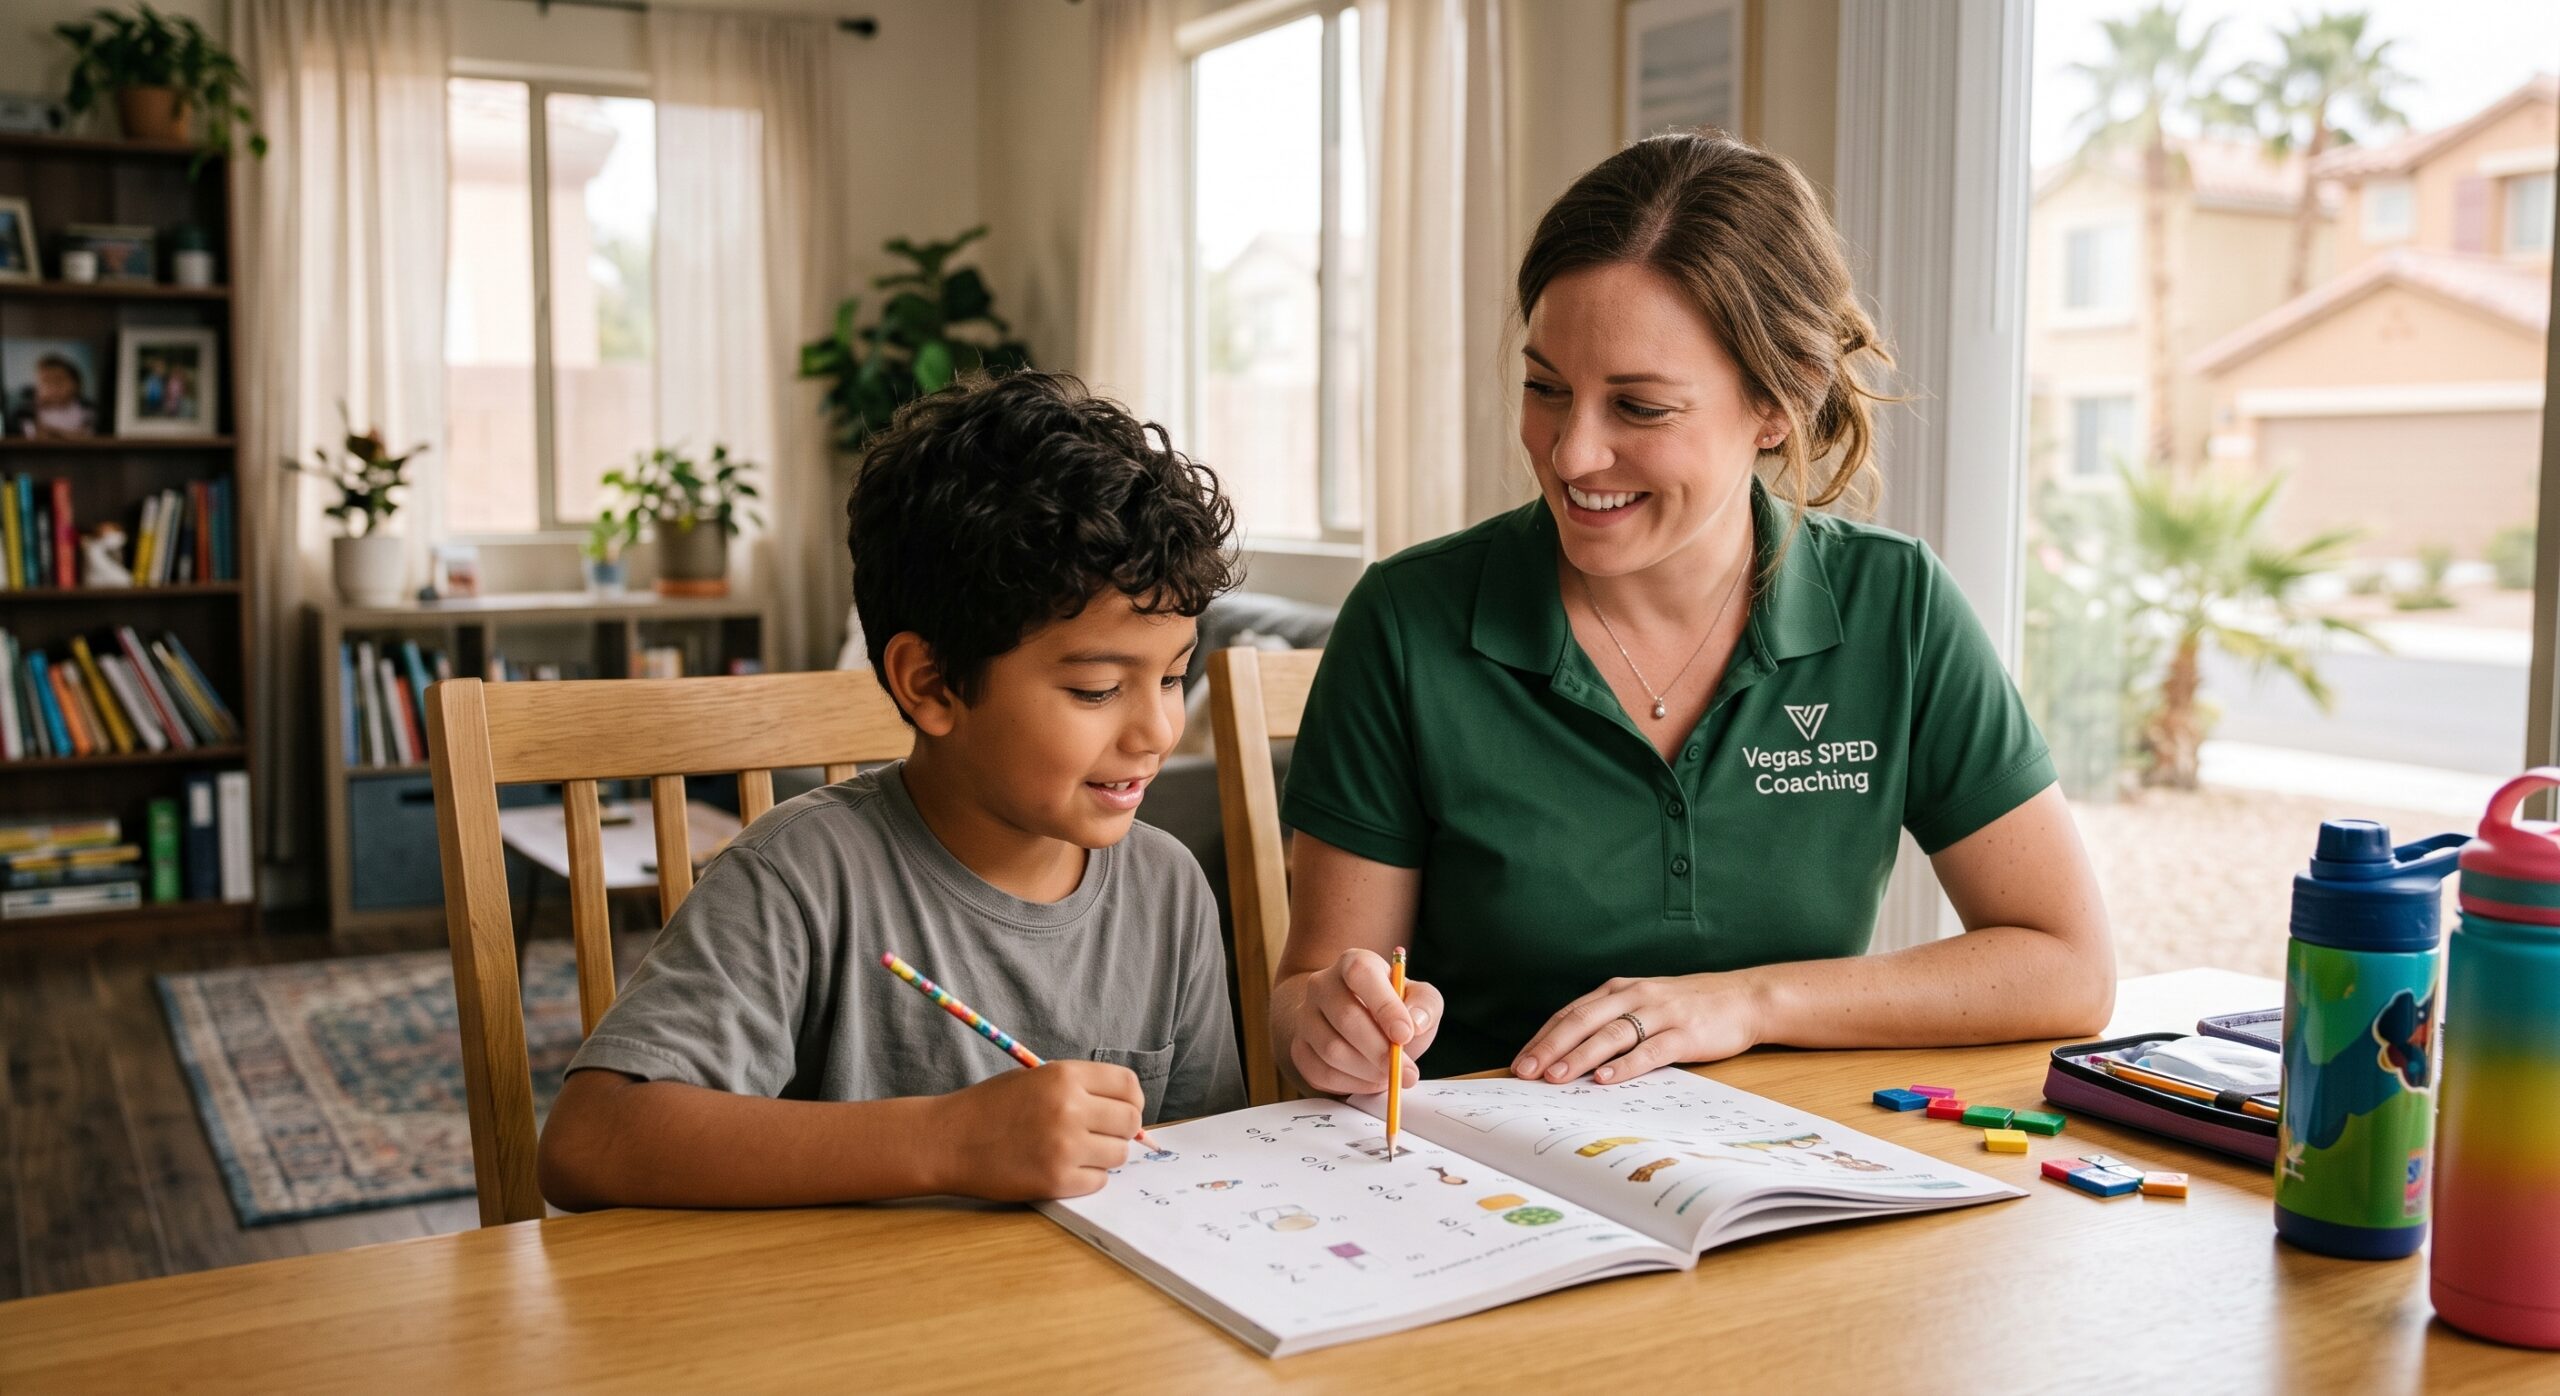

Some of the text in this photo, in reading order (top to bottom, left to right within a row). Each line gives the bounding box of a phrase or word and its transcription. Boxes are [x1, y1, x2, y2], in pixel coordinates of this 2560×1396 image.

[1742, 740, 1878, 772] Vegas SPED
[1755, 770, 1870, 794] Coaching
